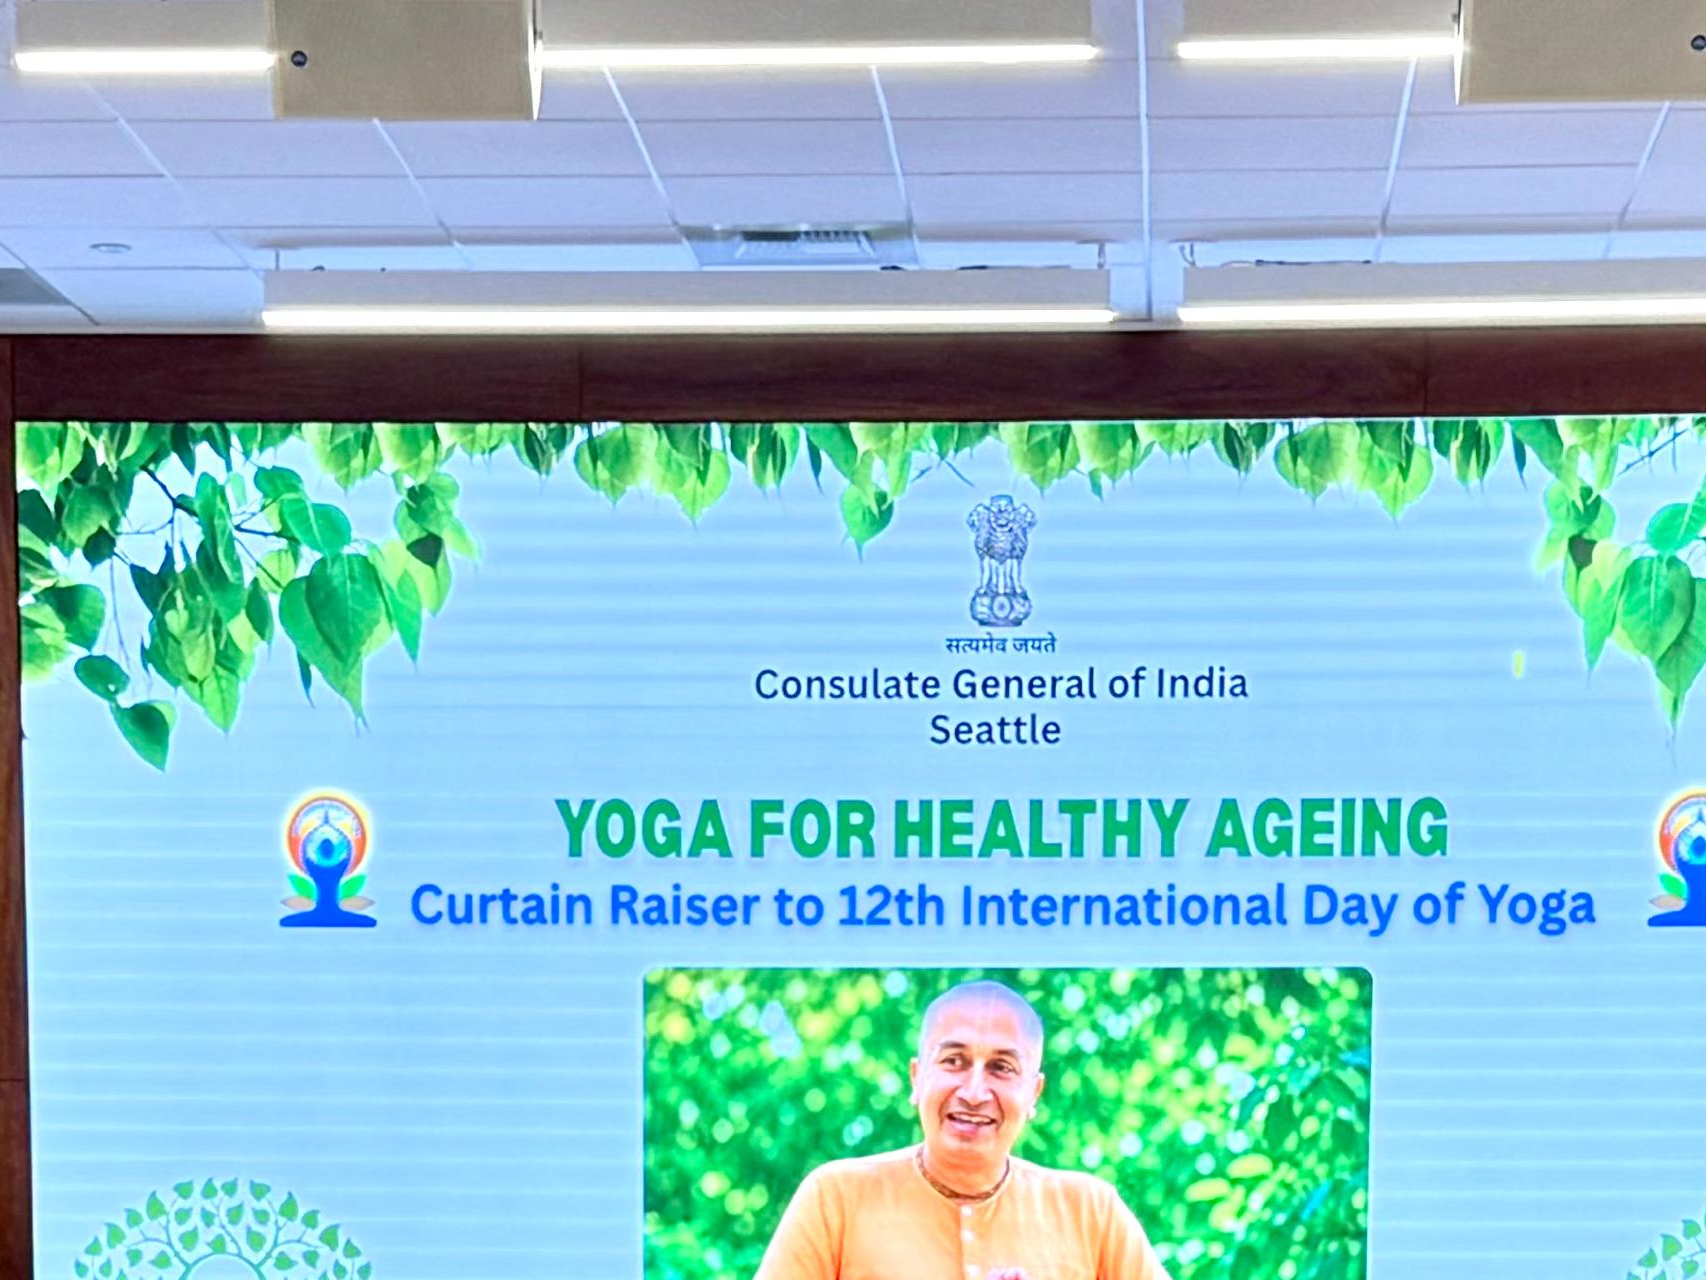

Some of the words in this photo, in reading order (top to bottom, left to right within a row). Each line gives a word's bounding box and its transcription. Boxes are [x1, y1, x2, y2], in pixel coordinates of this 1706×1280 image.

[945, 631, 1008, 654] सत्यमेव
[1012, 631, 1057, 654] जयते
[754, 668, 941, 699] Consulate
[952, 667, 1097, 699] General
[1108, 667, 1146, 698] of
[1157, 666, 1249, 698] India
[930, 713, 1062, 745] Seattle
[554, 798, 733, 859] YOGA
[750, 798, 876, 858] FOR
[893, 798, 1191, 858] HEALTHY
[1204, 797, 1448, 858] AGEING
[410, 883, 592, 926] Curtain
[611, 884, 760, 926] Raiser
[774, 887, 825, 926] to
[838, 884, 945, 926] 12th
[963, 883, 1287, 926] International
[1304, 884, 1398, 938] Day
[1412, 881, 1466, 926] of
[1477, 884, 1597, 936] Yoga
